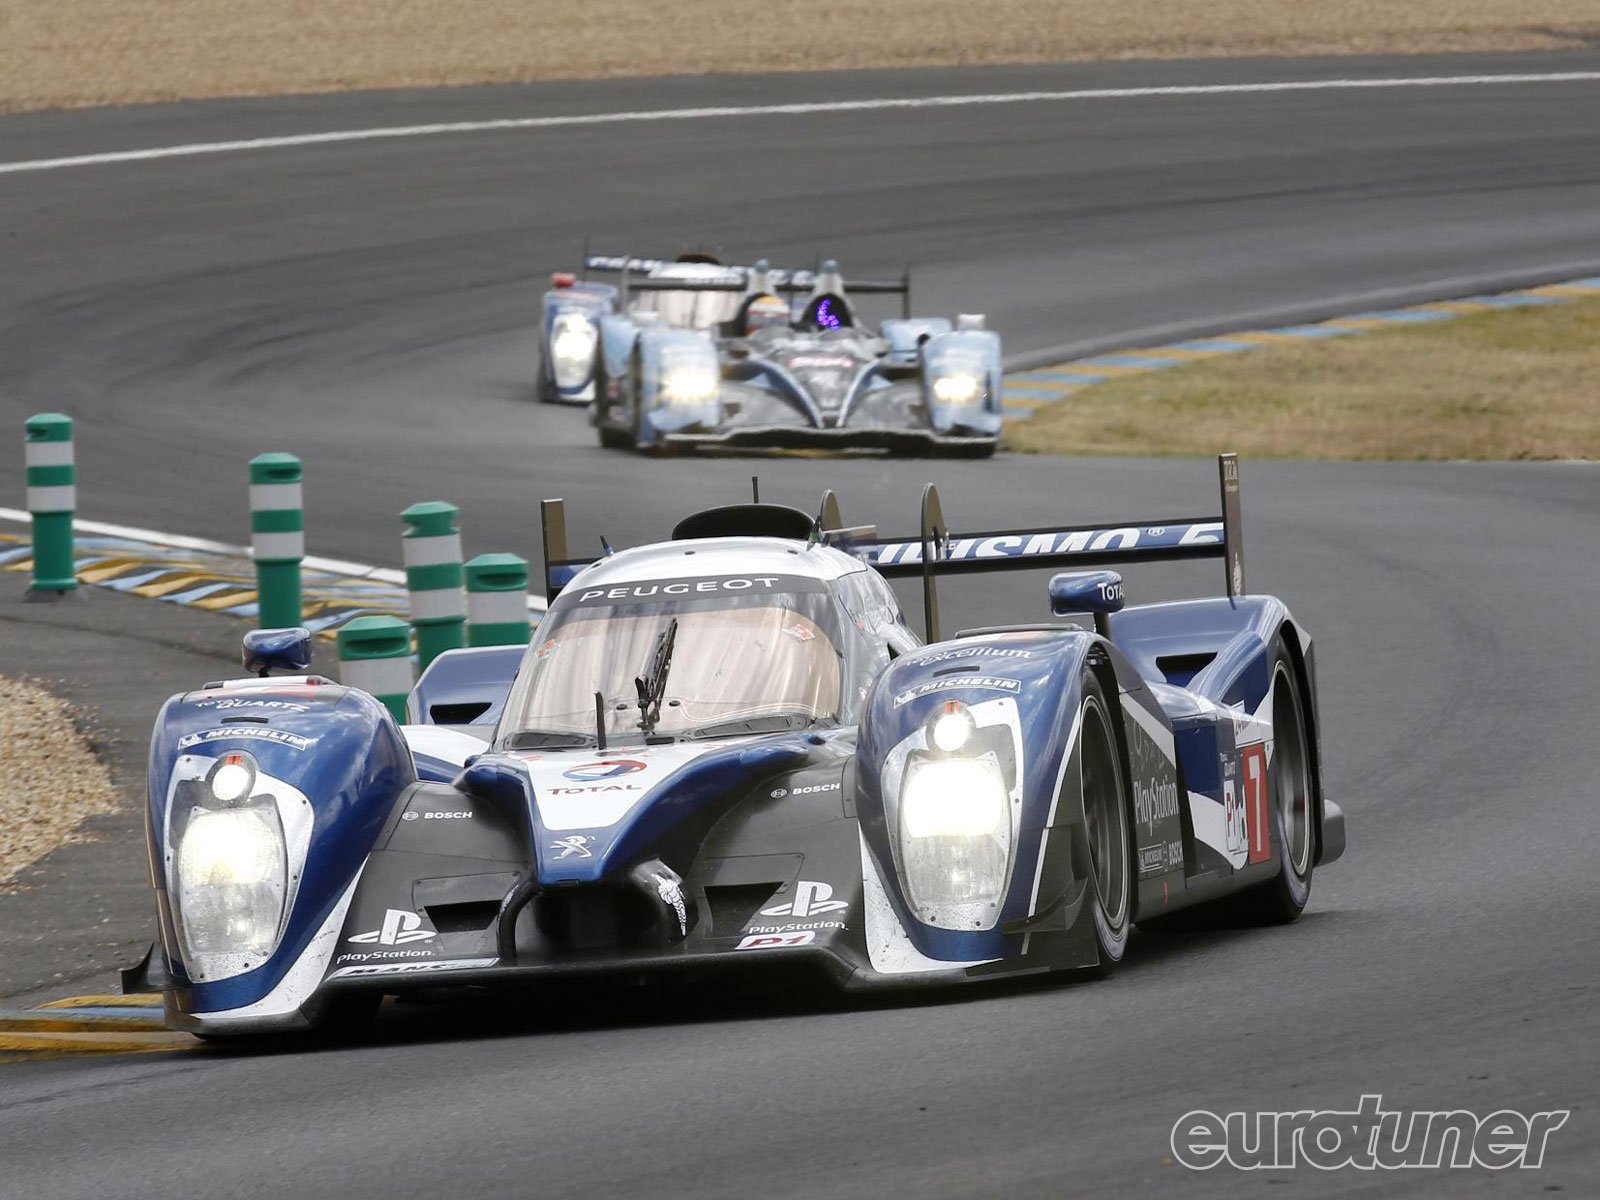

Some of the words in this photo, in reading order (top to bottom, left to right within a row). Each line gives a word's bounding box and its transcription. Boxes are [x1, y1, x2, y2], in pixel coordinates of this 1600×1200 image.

[579, 577, 779, 602] PEUGEOT
[1097, 582, 1126, 601] TOTA
[919, 678, 1018, 693] MICHELIN
[205, 727, 310, 745] MICHELIN
[546, 783, 643, 796] TOTAL
[792, 782, 841, 795] BOSCH
[1133, 776, 1180, 837] PlayStation
[424, 811, 473, 820] BOSCH
[748, 919, 846, 934] PlayStation
[336, 950, 432, 964] PlayStation
